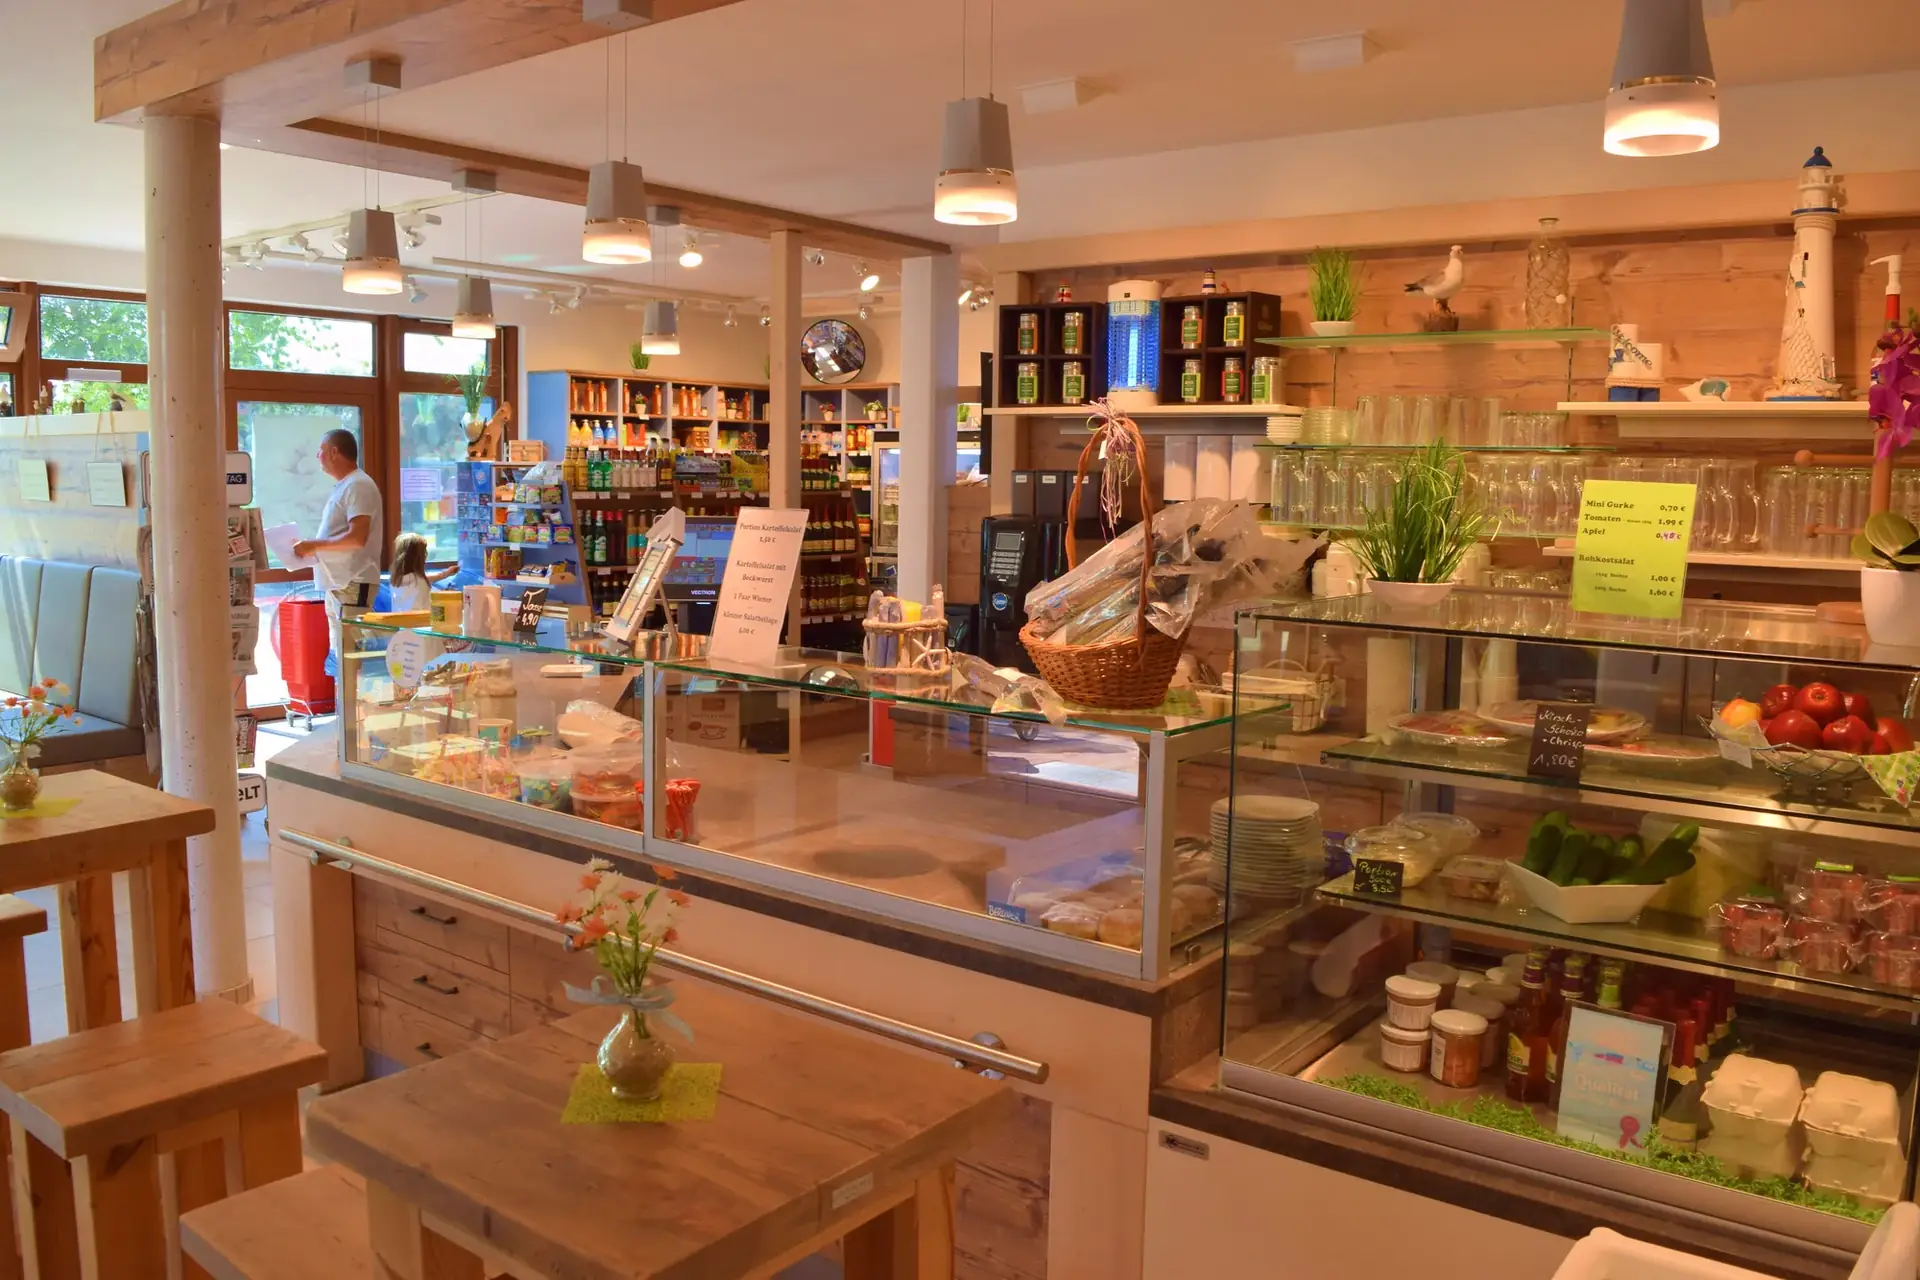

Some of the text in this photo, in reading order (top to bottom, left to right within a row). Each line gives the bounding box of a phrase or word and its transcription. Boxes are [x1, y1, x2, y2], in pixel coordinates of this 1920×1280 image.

[1612, 325, 1653, 371] Welcome
[1586, 500, 1605, 508] Mini
[1607, 501, 1635, 509] Gurke
[1584, 513, 1621, 522] Tomaten
[740, 522, 761, 531] Portion
[1582, 528, 1605, 536] Apfel
[1578, 554, 1635, 565] Rohkostsalat
[742, 573, 774, 584] Bockwurst
[738, 592, 751, 601] Paar
[1648, 588, 1668, 597] 1,60
[1359, 861, 1399, 877] Portion
